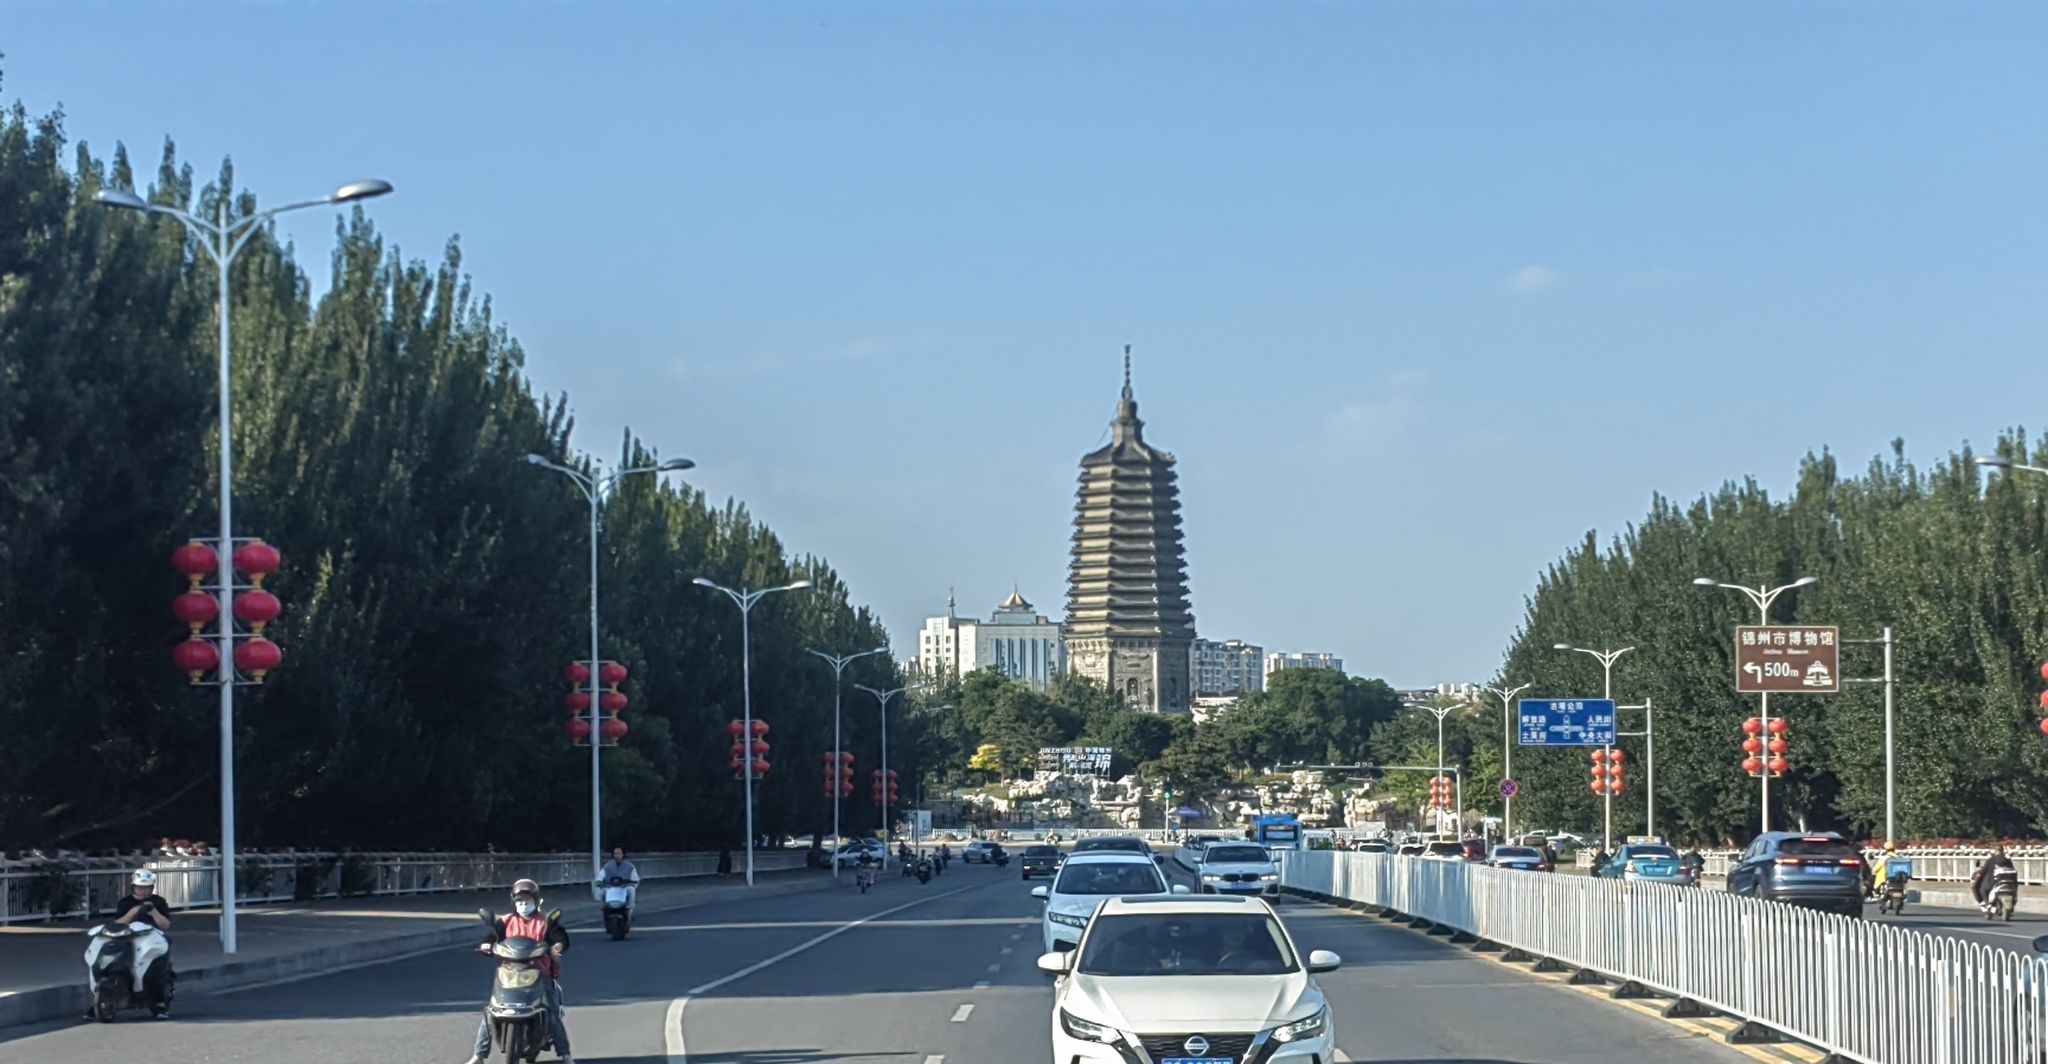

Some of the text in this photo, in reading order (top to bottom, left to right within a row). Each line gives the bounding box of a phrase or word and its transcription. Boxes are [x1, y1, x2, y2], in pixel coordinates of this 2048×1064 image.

[1742, 631, 1833, 645] 锦州市博物馆
[1764, 662, 1799, 676] 500m
[1579, 731, 1612, 739] 中央大街
